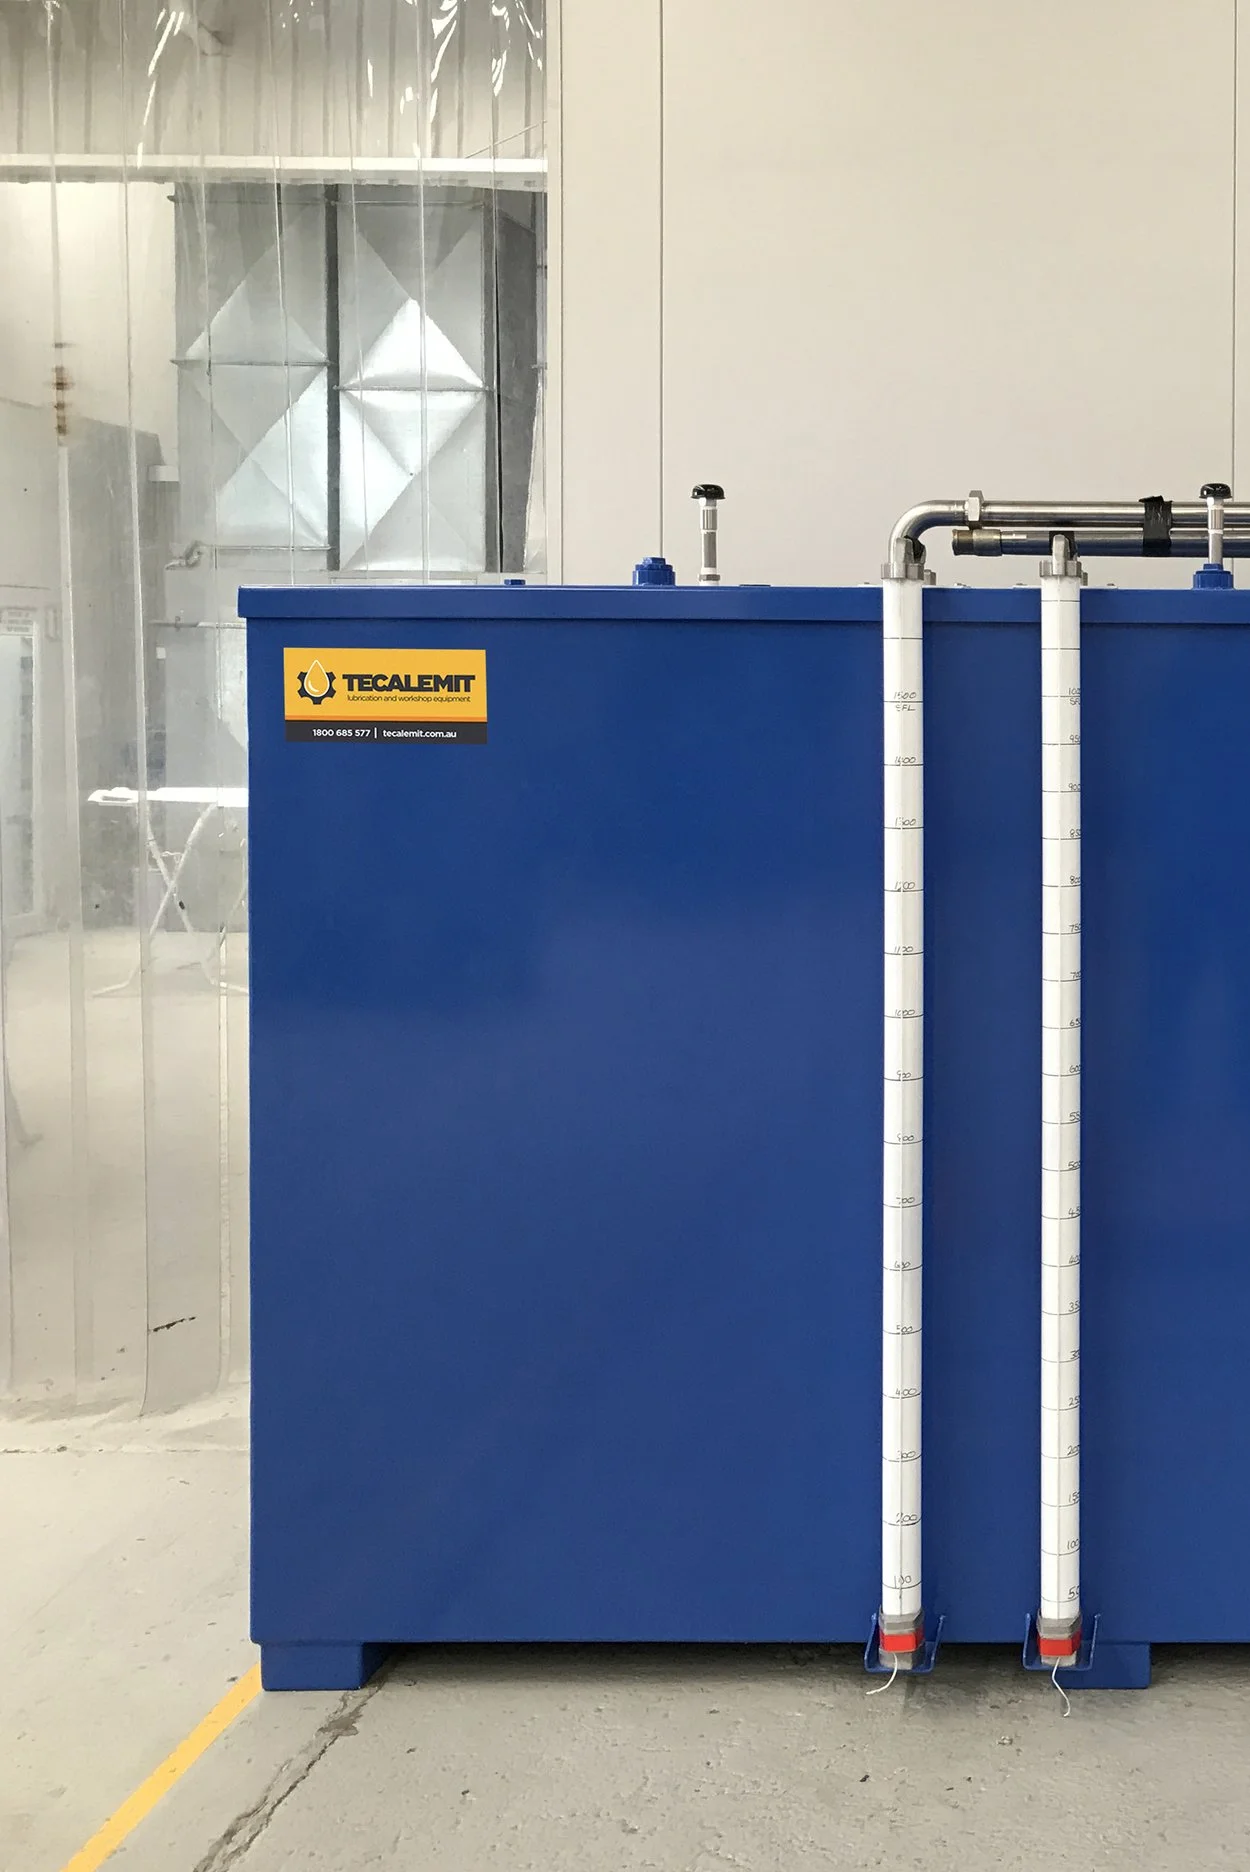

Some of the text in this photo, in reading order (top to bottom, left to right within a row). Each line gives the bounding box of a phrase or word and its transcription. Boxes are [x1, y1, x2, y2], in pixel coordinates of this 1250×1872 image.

[342, 674, 475, 692] TECALEMIT
[398, 695, 433, 703] workshop
[433, 695, 471, 703] equipment
[312, 729, 457, 738] 1800 685 577 tecalemit.com.au
